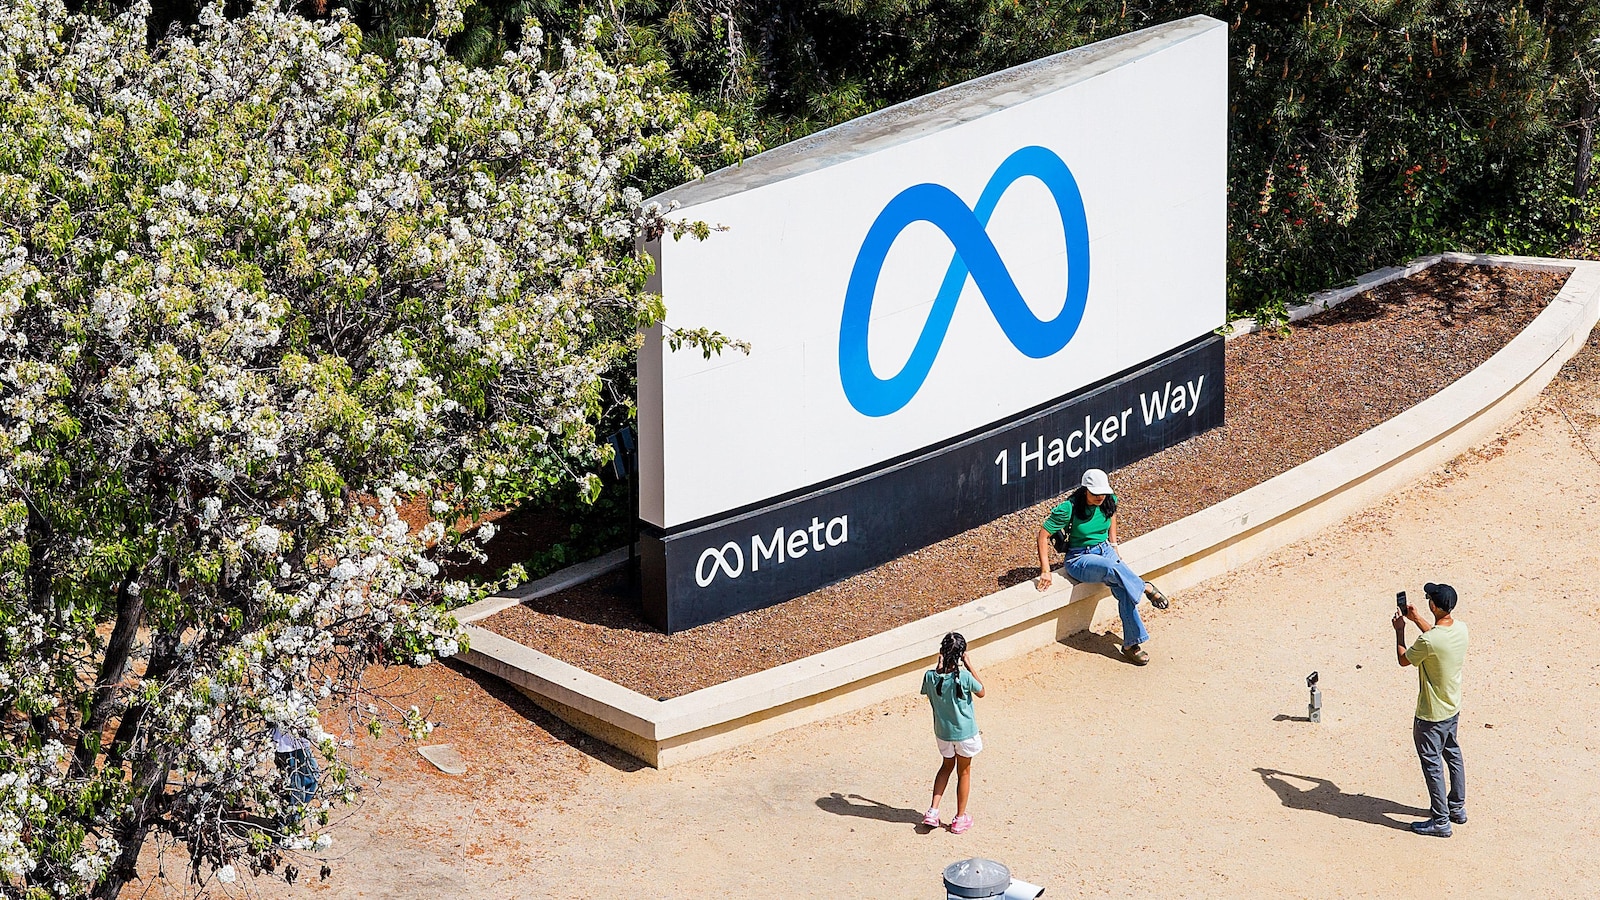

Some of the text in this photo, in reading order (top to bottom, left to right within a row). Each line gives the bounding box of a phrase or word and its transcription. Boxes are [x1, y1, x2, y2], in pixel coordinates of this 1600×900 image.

[994, 374, 1205, 485] 1 Hacker Way
[751, 515, 848, 572] Meta
